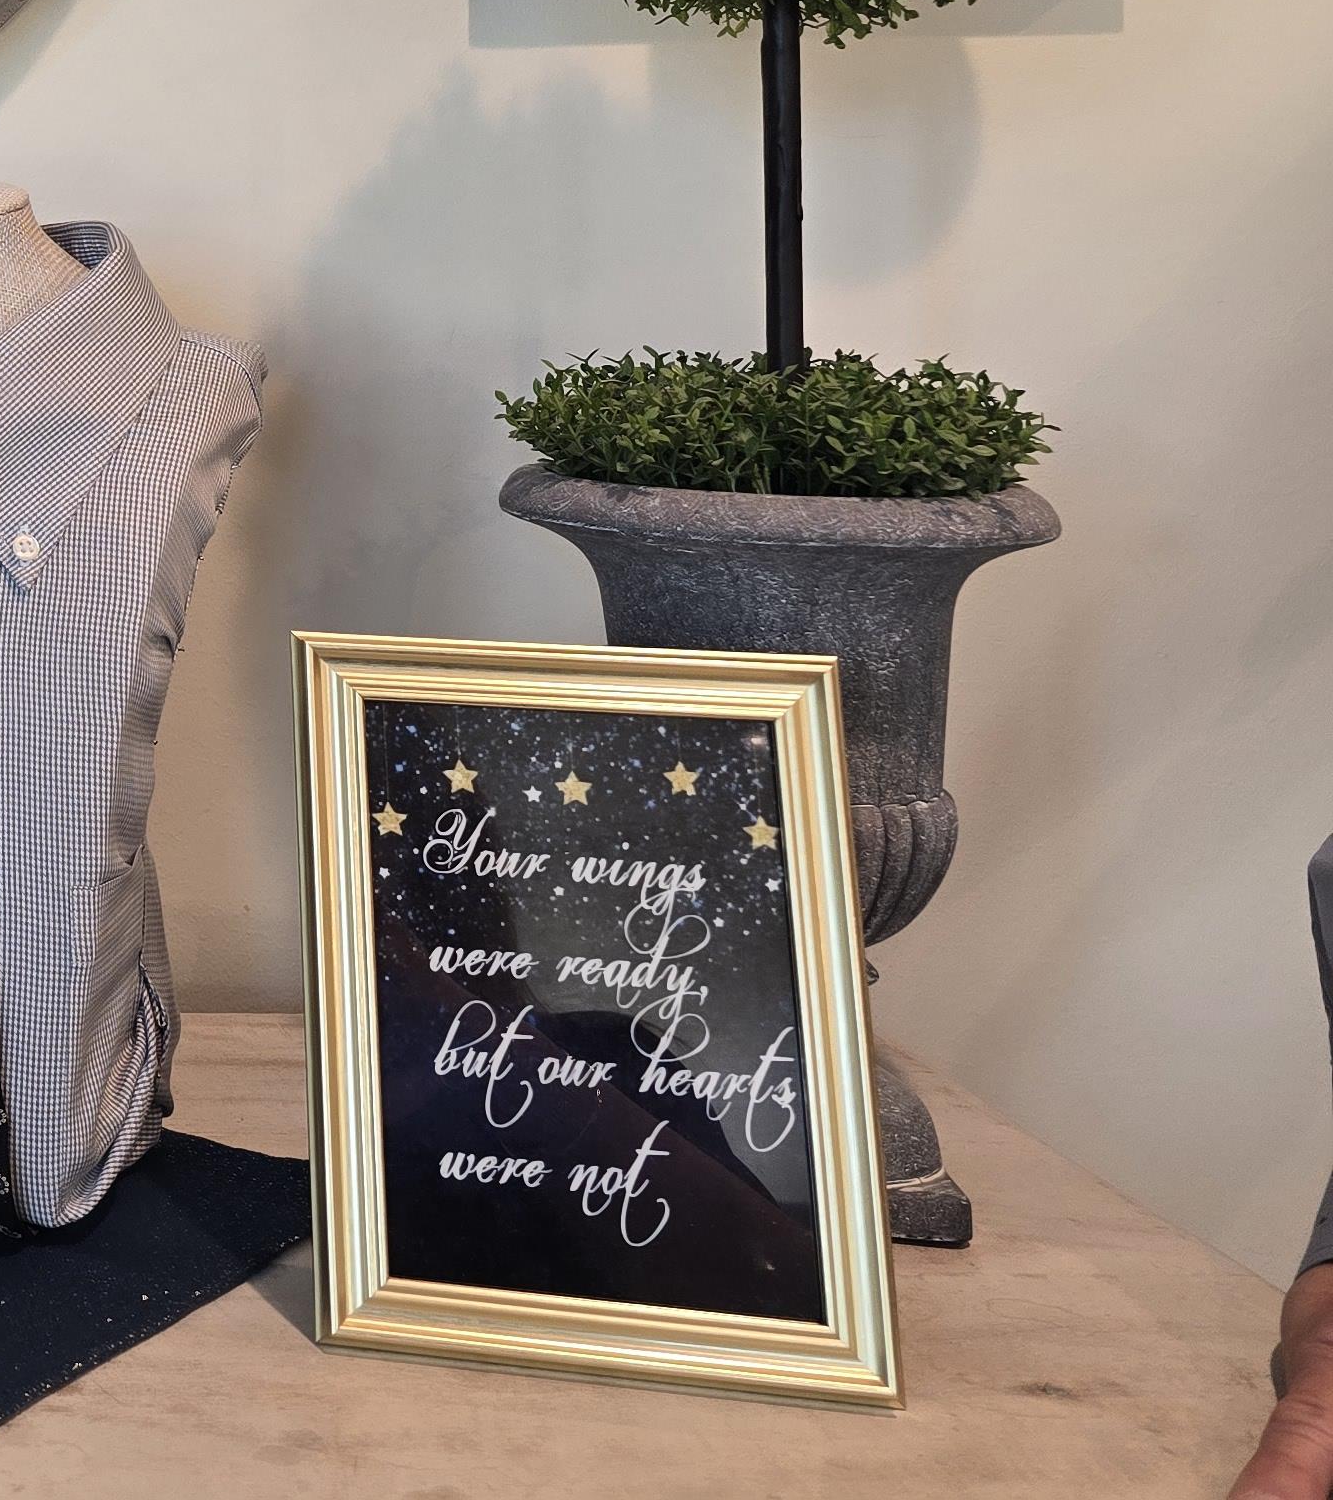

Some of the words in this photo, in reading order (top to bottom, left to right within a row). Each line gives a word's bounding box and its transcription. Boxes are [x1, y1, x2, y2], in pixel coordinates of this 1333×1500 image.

[423, 808, 547, 879] Your
[571, 850, 707, 954] wings
[428, 946, 540, 979] were
[434, 1000, 535, 1128] but
[537, 1055, 618, 1088] our
[638, 1013, 796, 1152] hearts
[438, 1148, 552, 1189] were
[568, 1120, 670, 1247] not
